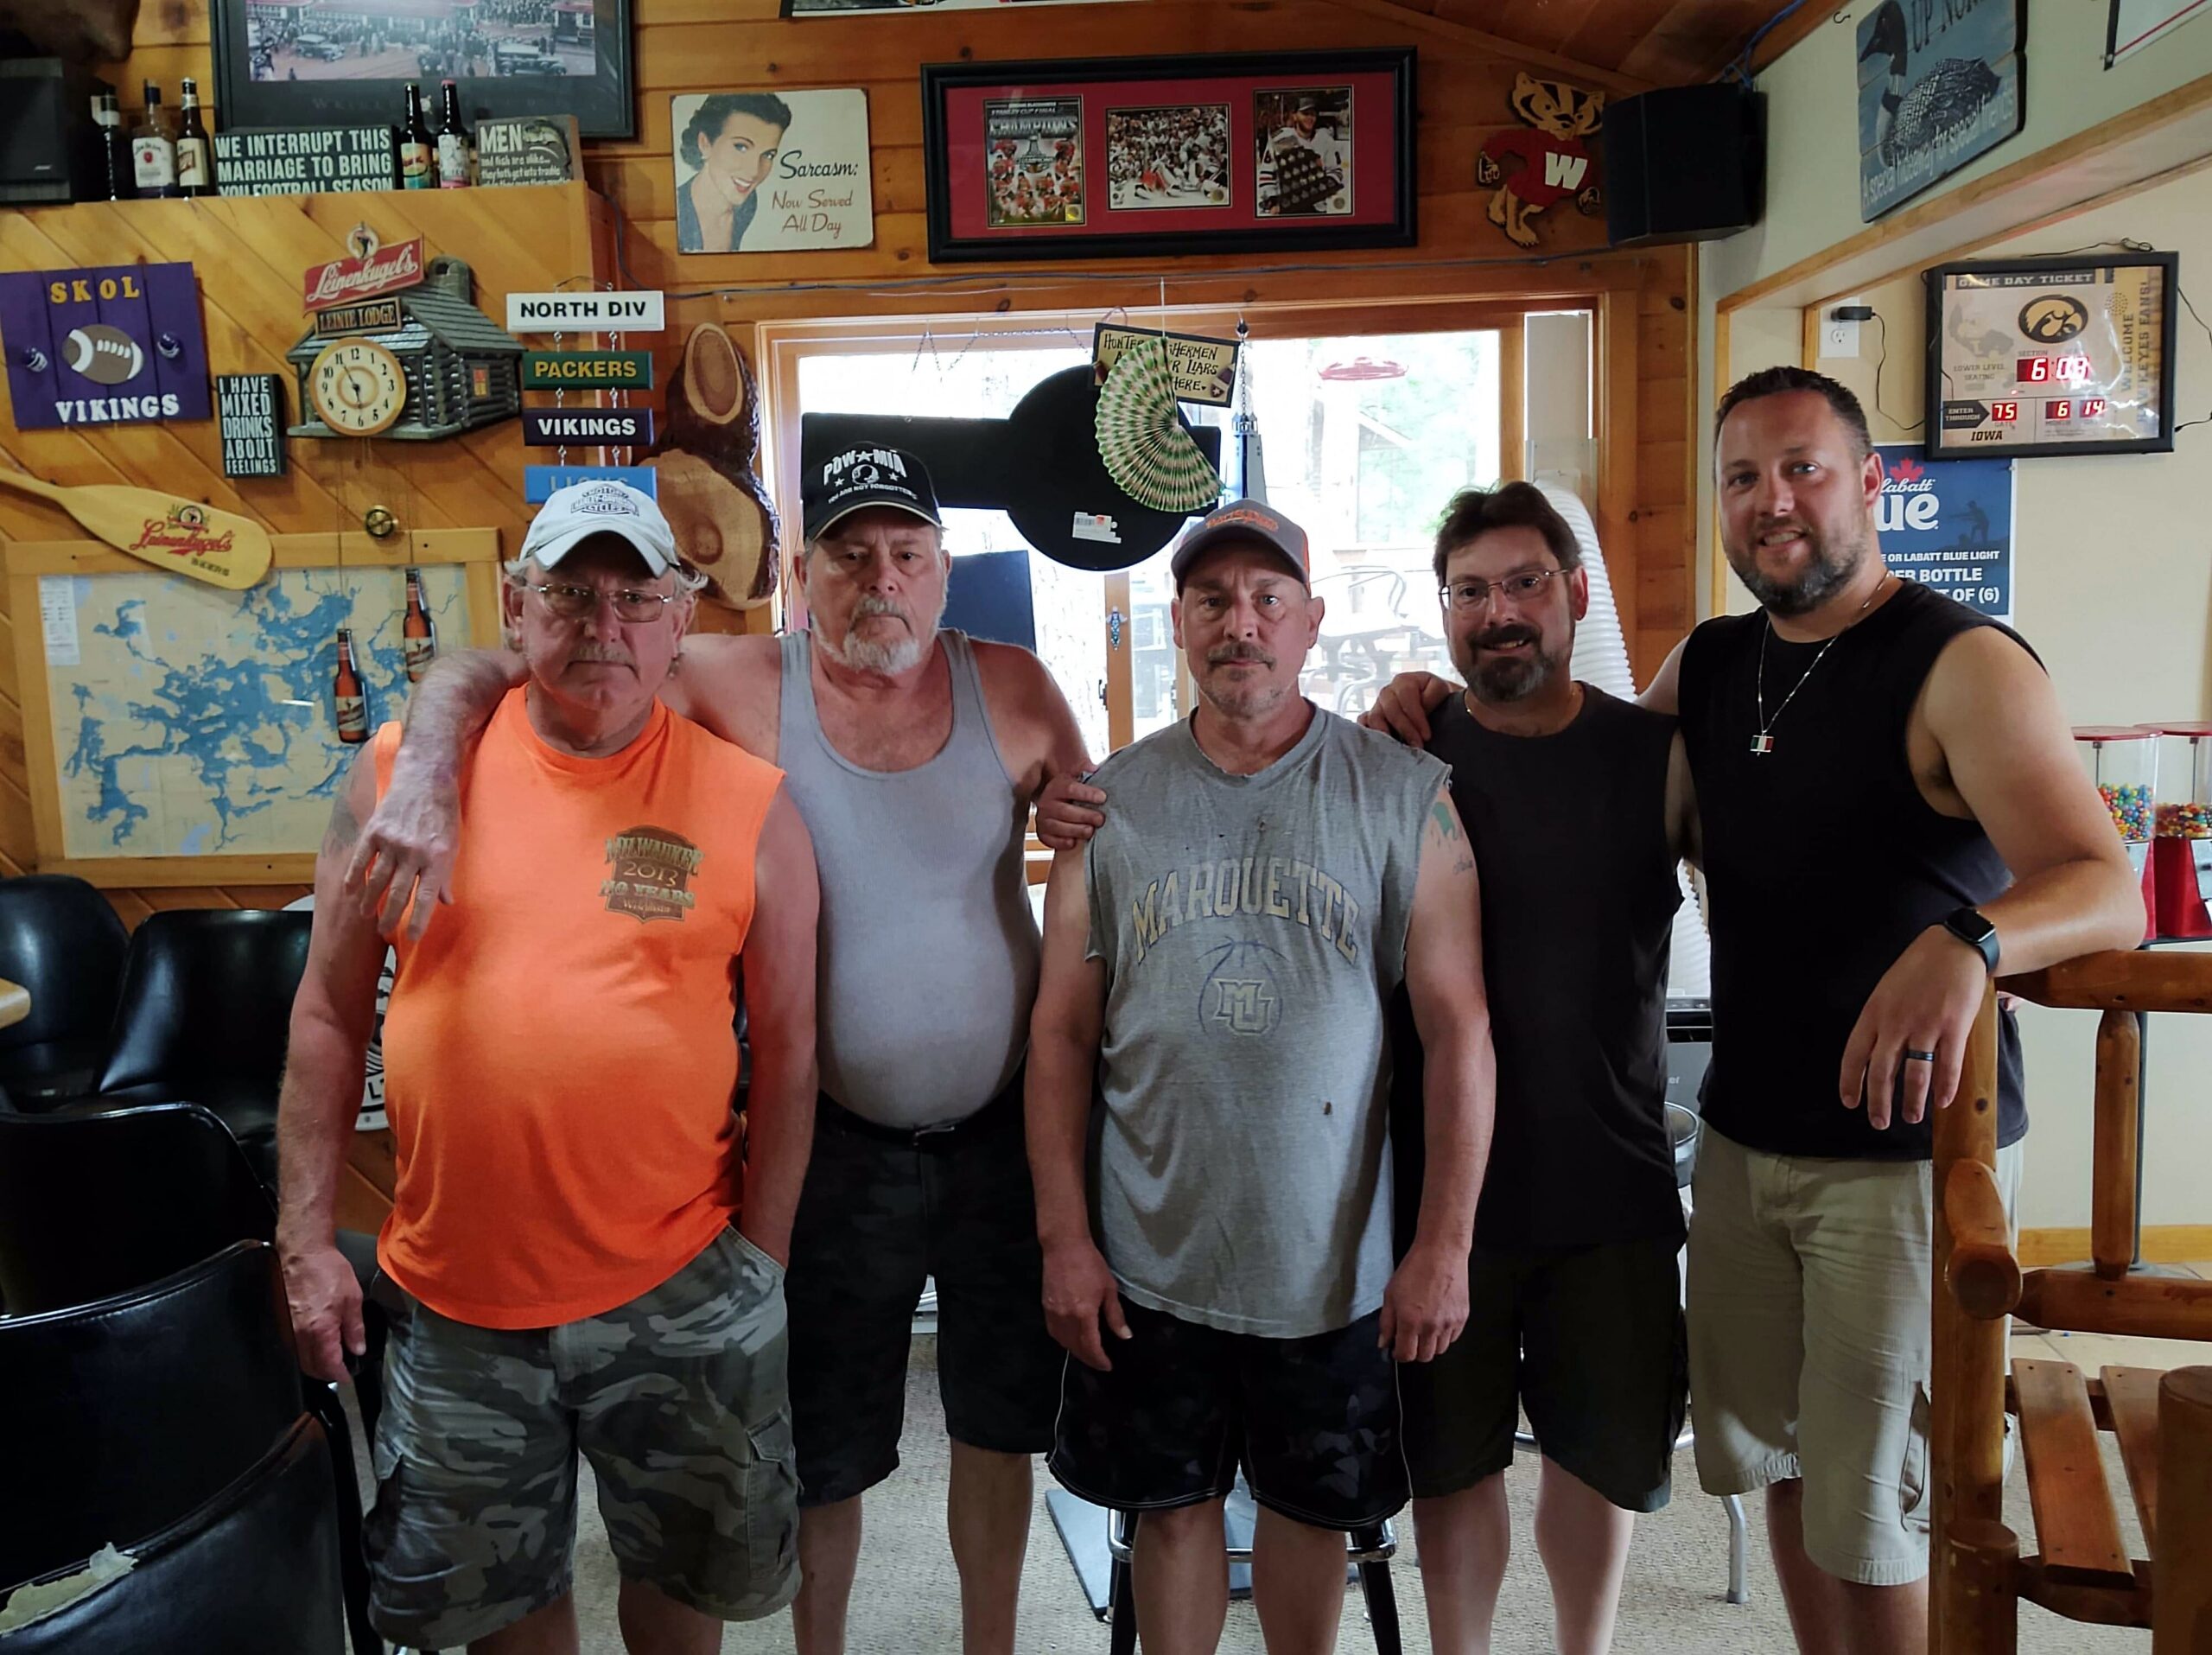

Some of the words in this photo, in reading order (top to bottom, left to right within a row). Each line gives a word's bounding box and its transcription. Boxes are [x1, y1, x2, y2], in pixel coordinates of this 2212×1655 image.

[215, 137, 241, 158] WE
[247, 130, 343, 156] INTERRUPT
[348, 128, 390, 151] THIS
[480, 124, 523, 153] MEN
[217, 157, 306, 182] MARRIAGE
[311, 156, 334, 178] TO
[339, 153, 392, 175] BRING
[779, 150, 858, 179] Sarcasm:
[1545, 151, 1588, 190] W
[332, 177, 393, 193] SEASON
[772, 191, 803, 210] Now
[808, 188, 854, 207] Served
[781, 213, 807, 232] All
[811, 213, 842, 239] Day
[306, 244, 418, 302] Leinenkugel's
[2005, 276, 2034, 285] DAY
[2039, 273, 2093, 283] TICKET
[50, 276, 140, 303] SKOL
[359, 305, 396, 326] LODGE
[520, 302, 598, 318] NORTH
[608, 301, 646, 316] DIV
[335, 353, 343, 365] 11
[351, 347, 359, 360] 12
[2121, 314, 2134, 391] WELCOME
[323, 366, 334, 379] 10
[382, 363, 387, 375] 2
[534, 360, 637, 378] PACKERS
[1186, 359, 1218, 375] LIARS
[219, 378, 225, 394] I
[230, 376, 270, 393] HAVE
[388, 379, 394, 391] 3
[55, 393, 180, 423] VIKINGS
[221, 393, 271, 417] MIXED
[1993, 403, 2016, 420] 75
[2057, 401, 2069, 417] 6
[2085, 400, 2103, 416] 14
[223, 416, 273, 439] DRINKS
[358, 416, 364, 427] 6
[537, 418, 637, 436] VIKINGS
[1971, 430, 2003, 442] IOWA
[226, 438, 274, 459] ABOUT
[226, 458, 276, 474] FEELINGS
[823, 449, 857, 486] POW
[873, 449, 907, 478] MIA
[1873, 493, 1940, 532] ue
[1887, 553, 1902, 562] OR
[1904, 552, 1942, 562] LABATT
[1942, 551, 1968, 561] BLUE
[1970, 551, 2000, 560] LIGHT
[1919, 567, 1983, 582] BOTTLE
[1953, 588, 1975, 602] OF
[1978, 587, 2000, 603] (6)
[623, 860, 678, 887] 2013
[1132, 856, 1361, 967] MARQUETTE
